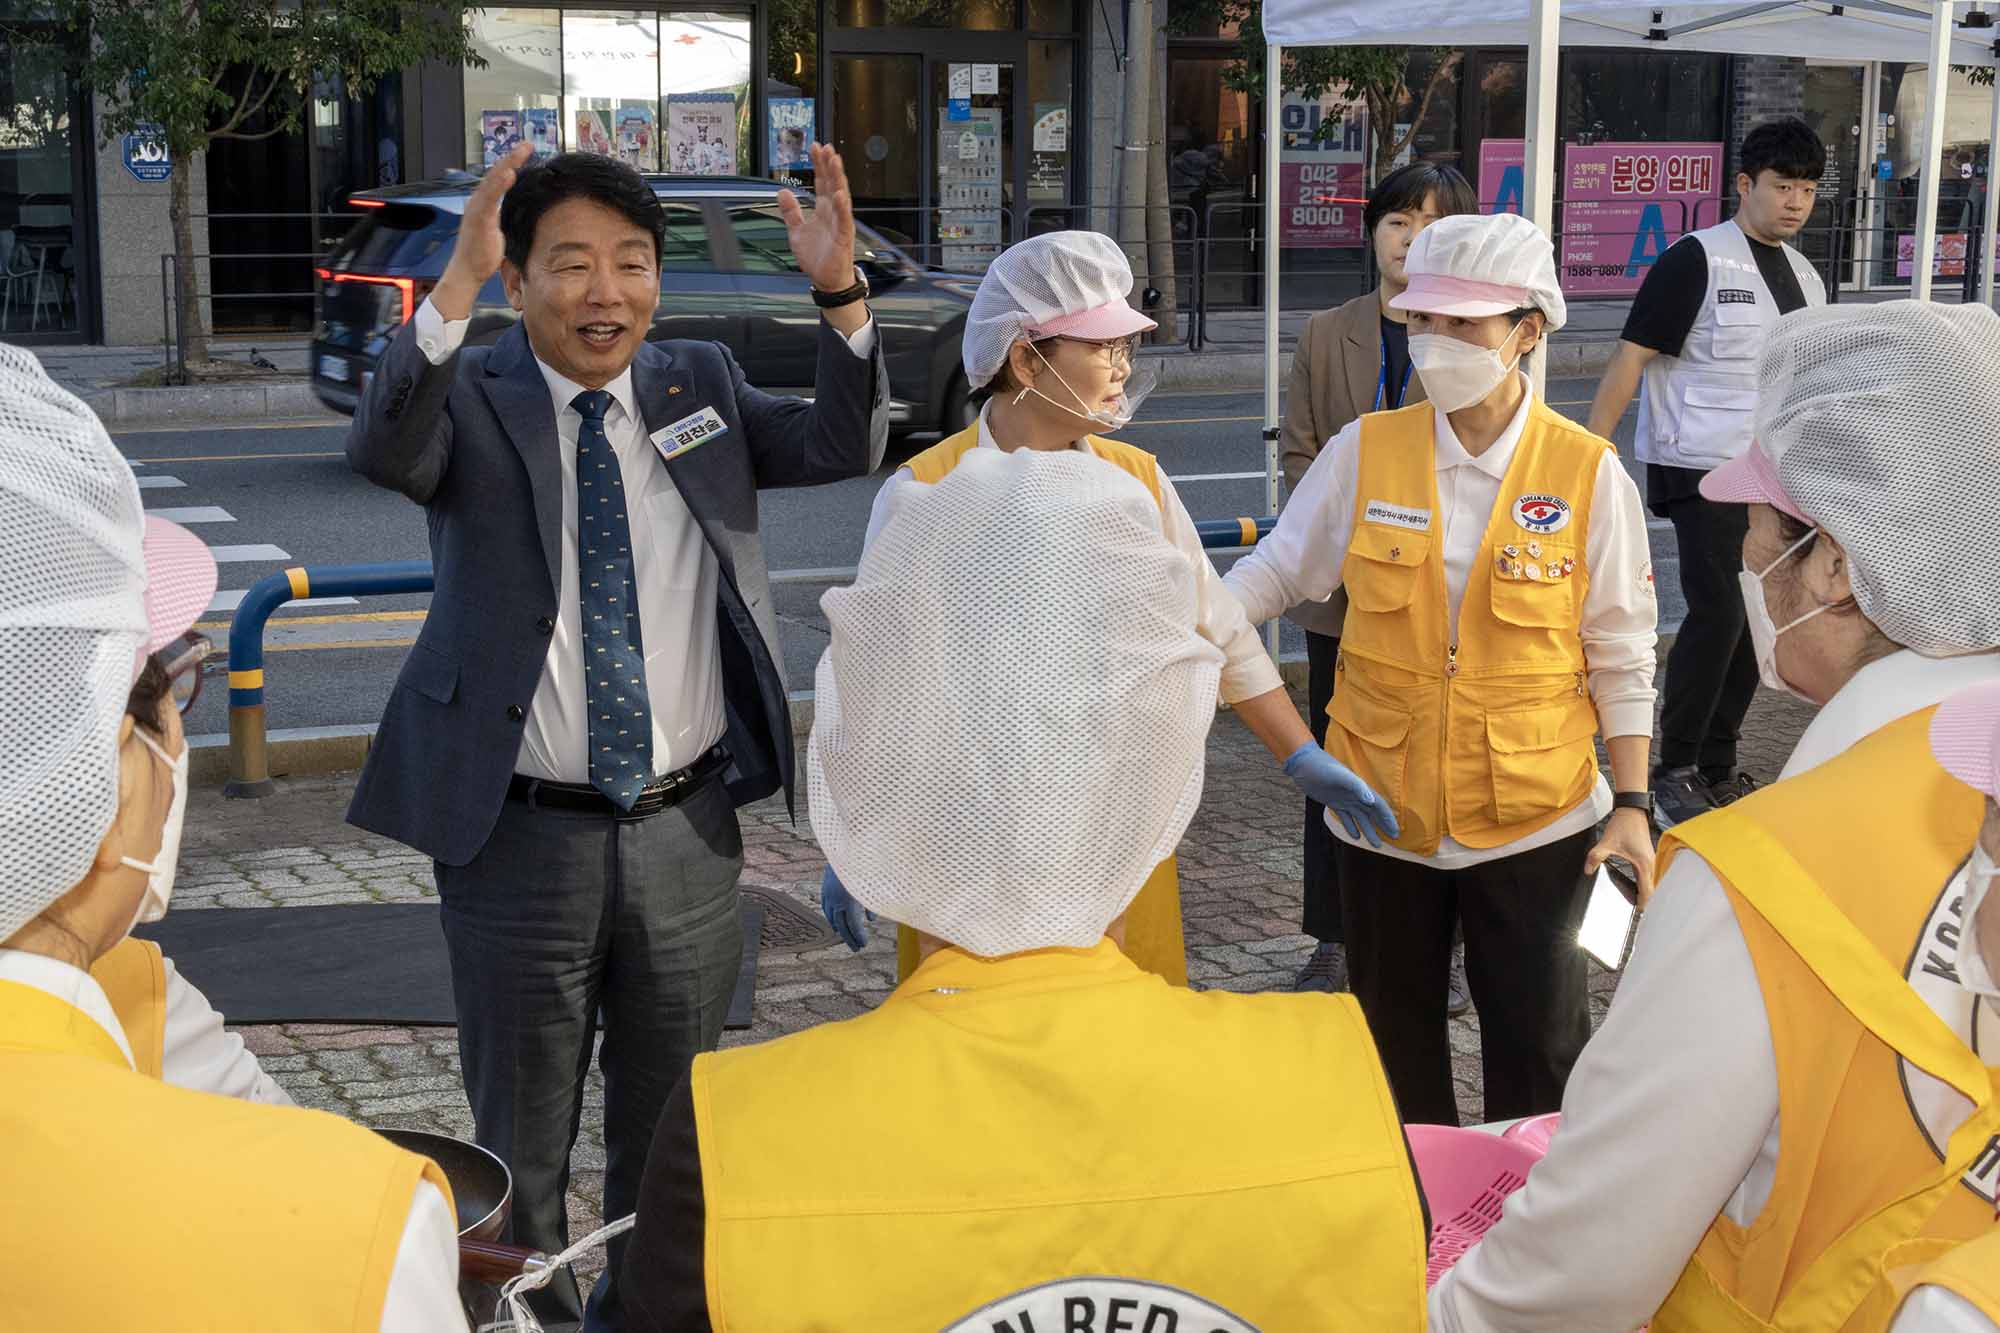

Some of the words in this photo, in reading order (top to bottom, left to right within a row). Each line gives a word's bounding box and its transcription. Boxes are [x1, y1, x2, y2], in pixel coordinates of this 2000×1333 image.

[1281, 104, 1364, 152] 임대
[1299, 164, 1338, 184] 042
[1299, 186, 1338, 205] 257
[1292, 207, 1344, 225] 8000
[1567, 252, 1593, 262] PHONE
[1567, 264, 1625, 277] 1588-0809
[1520, 495, 1541, 503] KOREAN
[1553, 498, 1567, 511] CROSS
